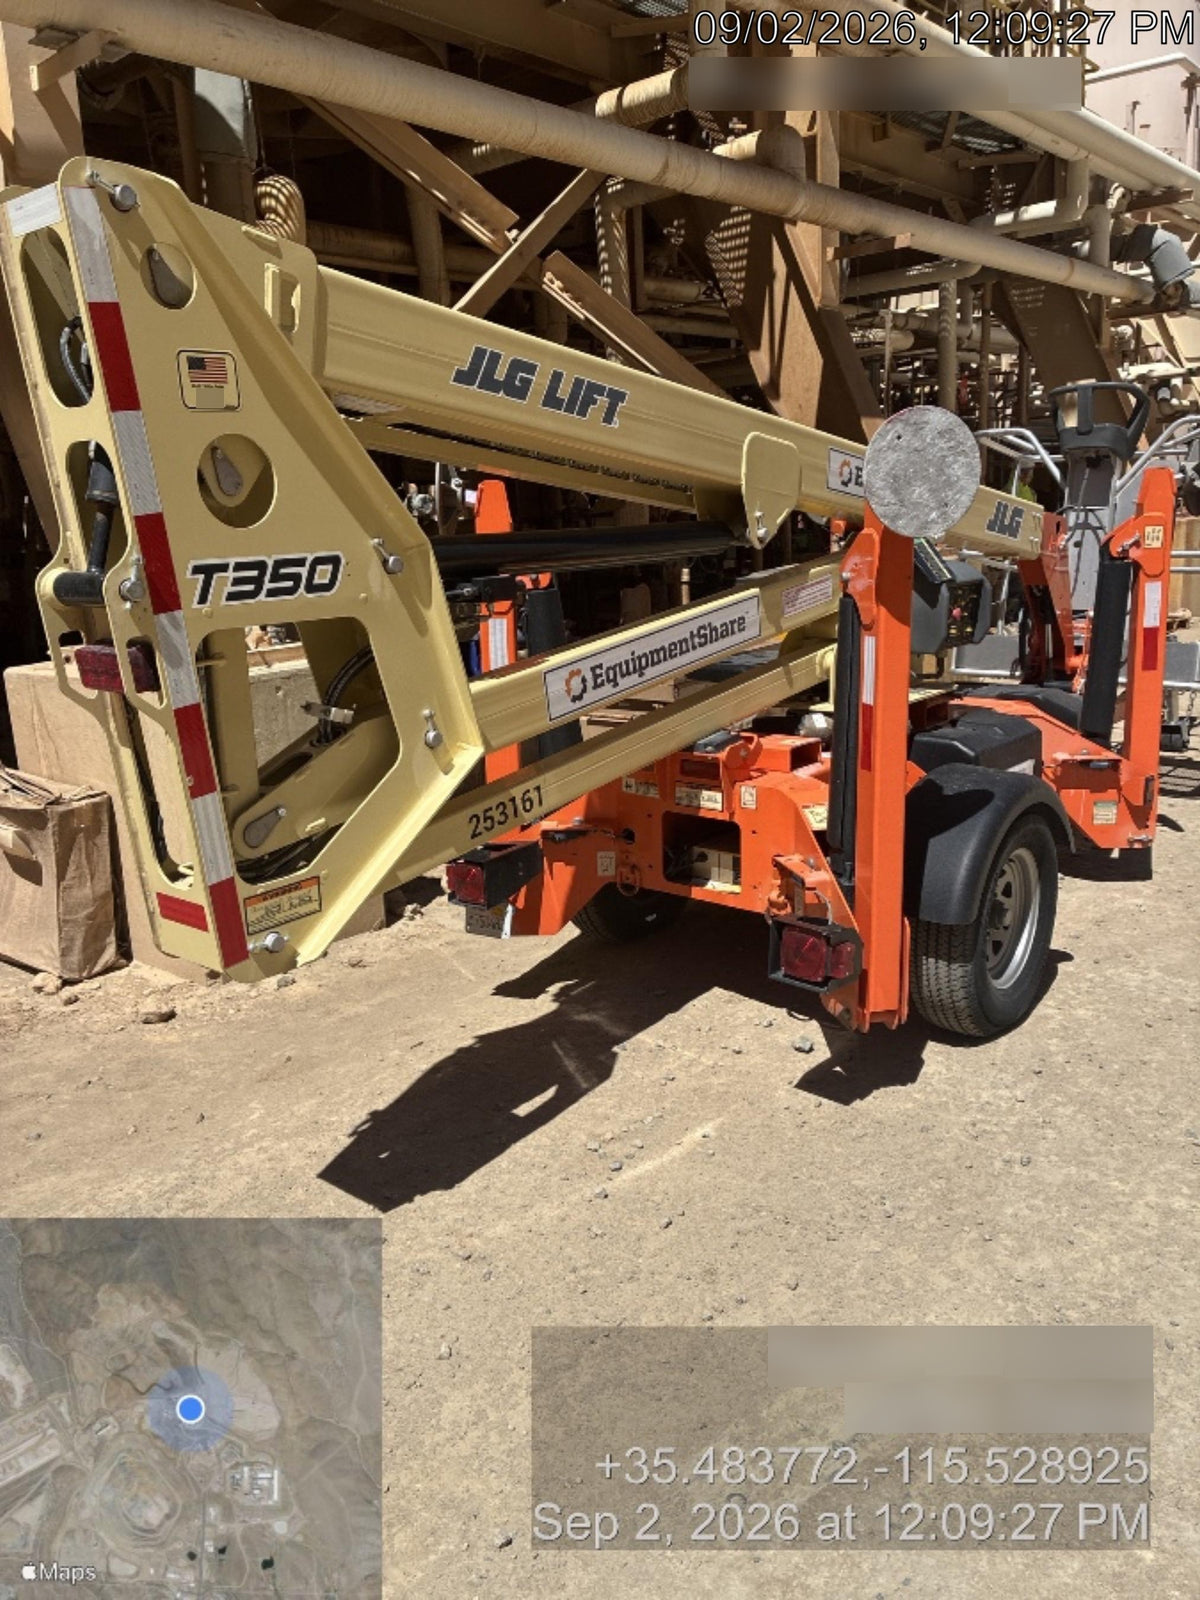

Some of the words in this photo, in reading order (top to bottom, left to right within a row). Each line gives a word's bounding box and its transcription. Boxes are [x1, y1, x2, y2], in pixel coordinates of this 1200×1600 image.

[450, 344, 541, 404] JLG
[539, 367, 630, 428] LIFT
[985, 499, 1025, 541] JLG
[187, 552, 344, 608] T350
[590, 614, 747, 690] EquipmentShare
[468, 784, 543, 840] 253161
